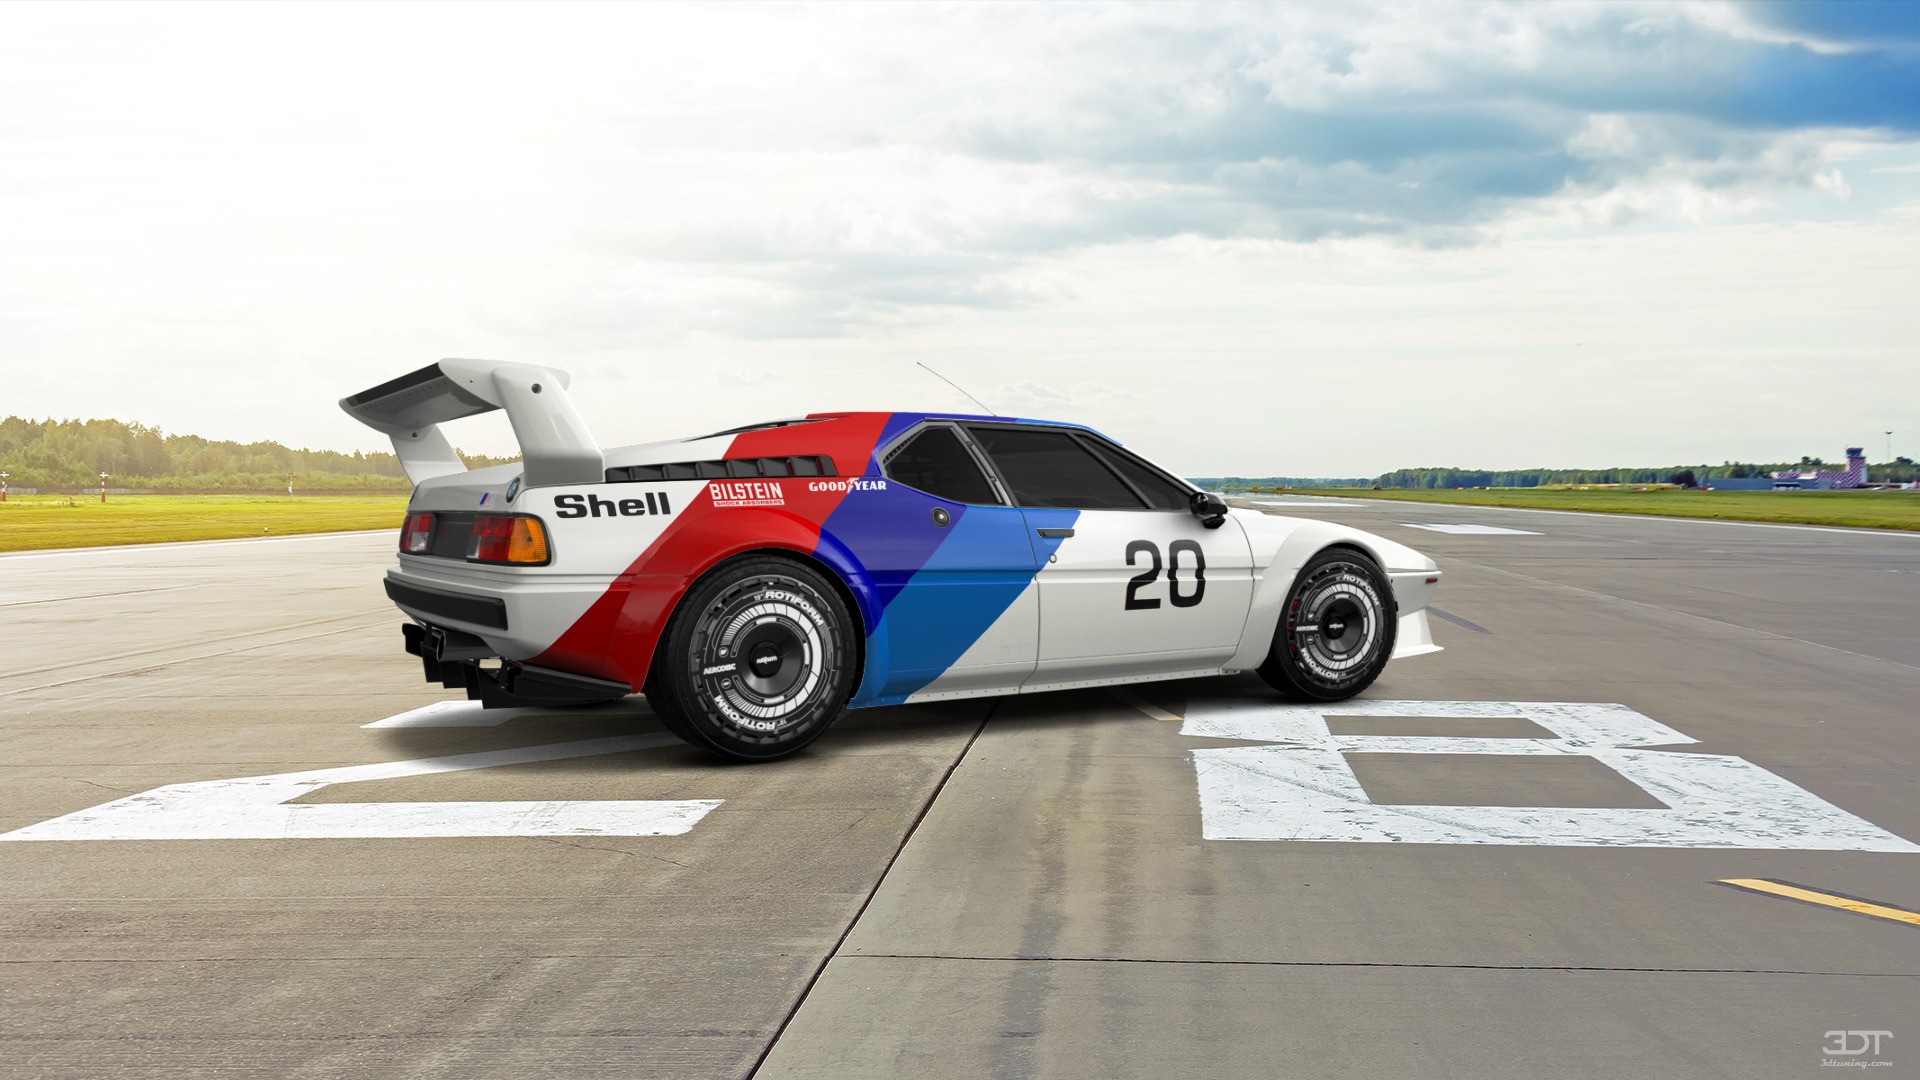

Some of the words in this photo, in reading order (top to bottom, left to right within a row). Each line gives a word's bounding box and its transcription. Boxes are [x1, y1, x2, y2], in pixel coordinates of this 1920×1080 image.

[554, 492, 671, 519] Shell
[709, 483, 783, 500] BILSTEIN
[1125, 539, 1206, 618] 20
[765, 591, 824, 626] ROTIFORM
[703, 663, 736, 675] AERODISC
[714, 695, 776, 730] ROTIFORM
